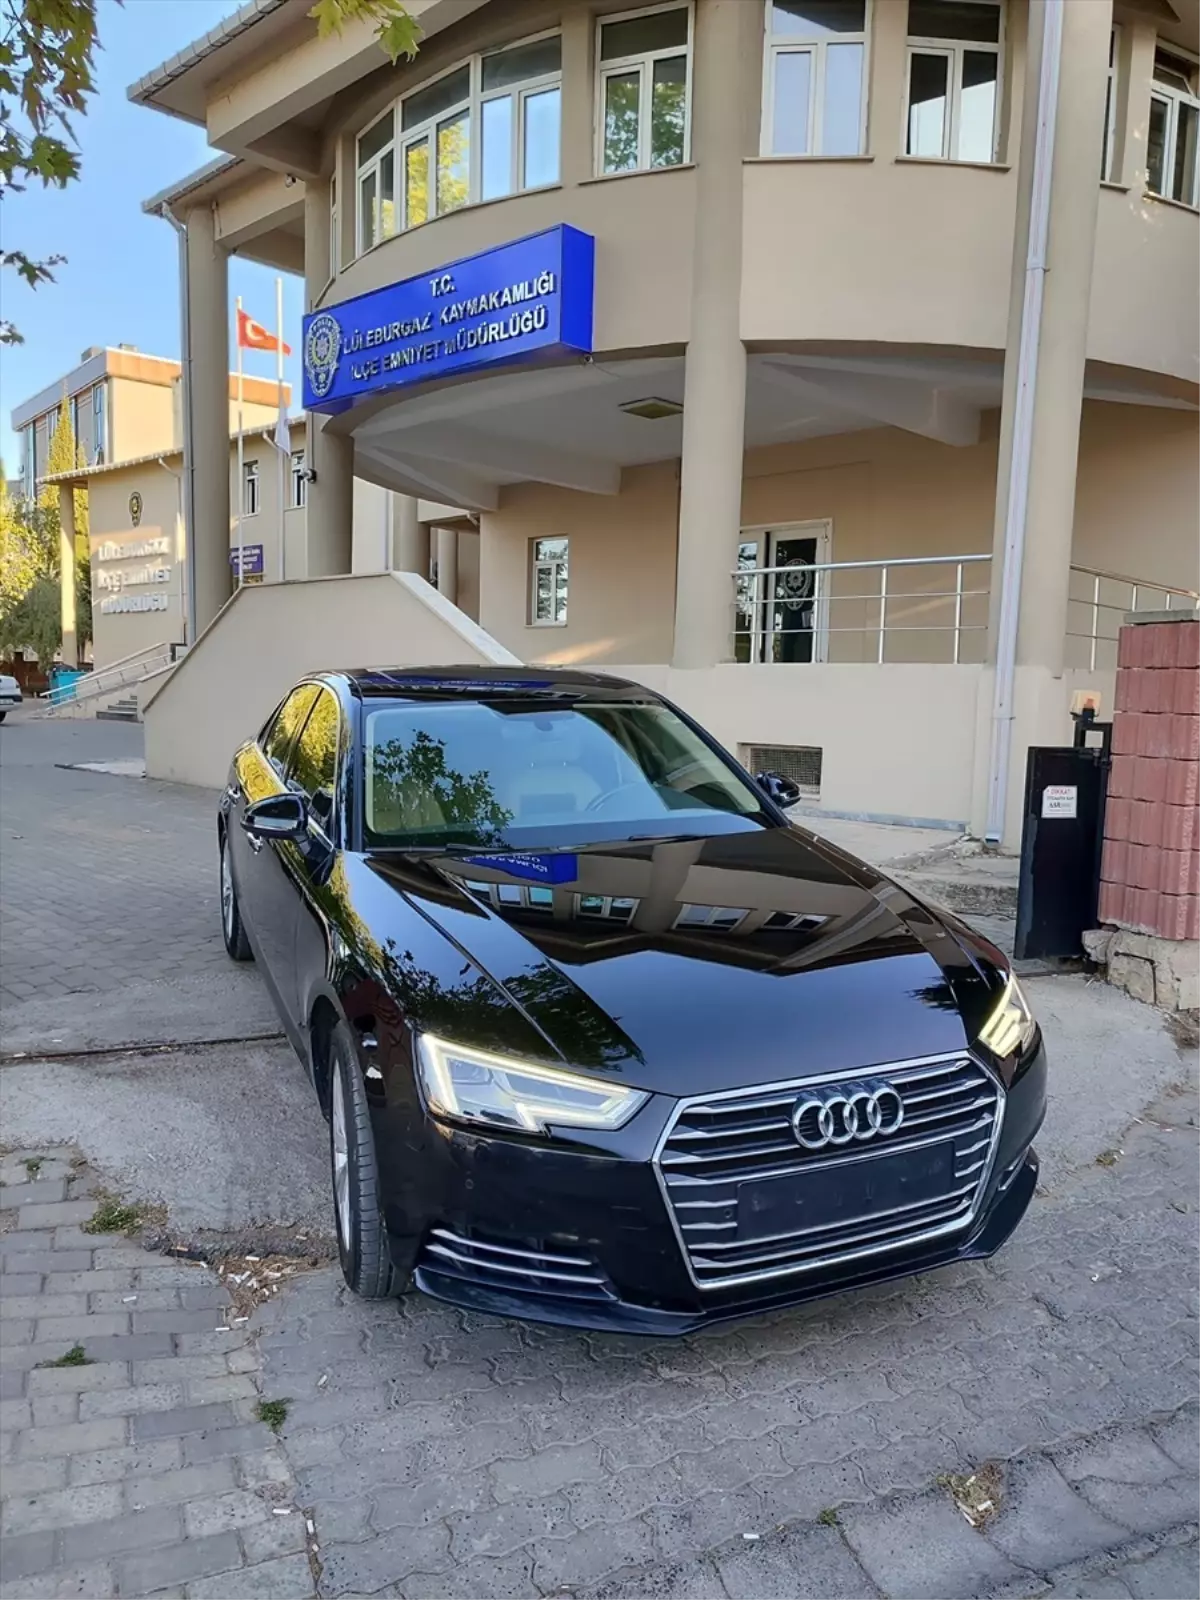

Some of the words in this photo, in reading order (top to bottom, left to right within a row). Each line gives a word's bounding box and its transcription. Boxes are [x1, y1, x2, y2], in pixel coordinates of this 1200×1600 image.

[430, 274, 455, 296] T.C.
[440, 271, 555, 324] KAYMAKAMLIĞI
[444, 308, 546, 356] MÜDÜRLÜĞÜ
